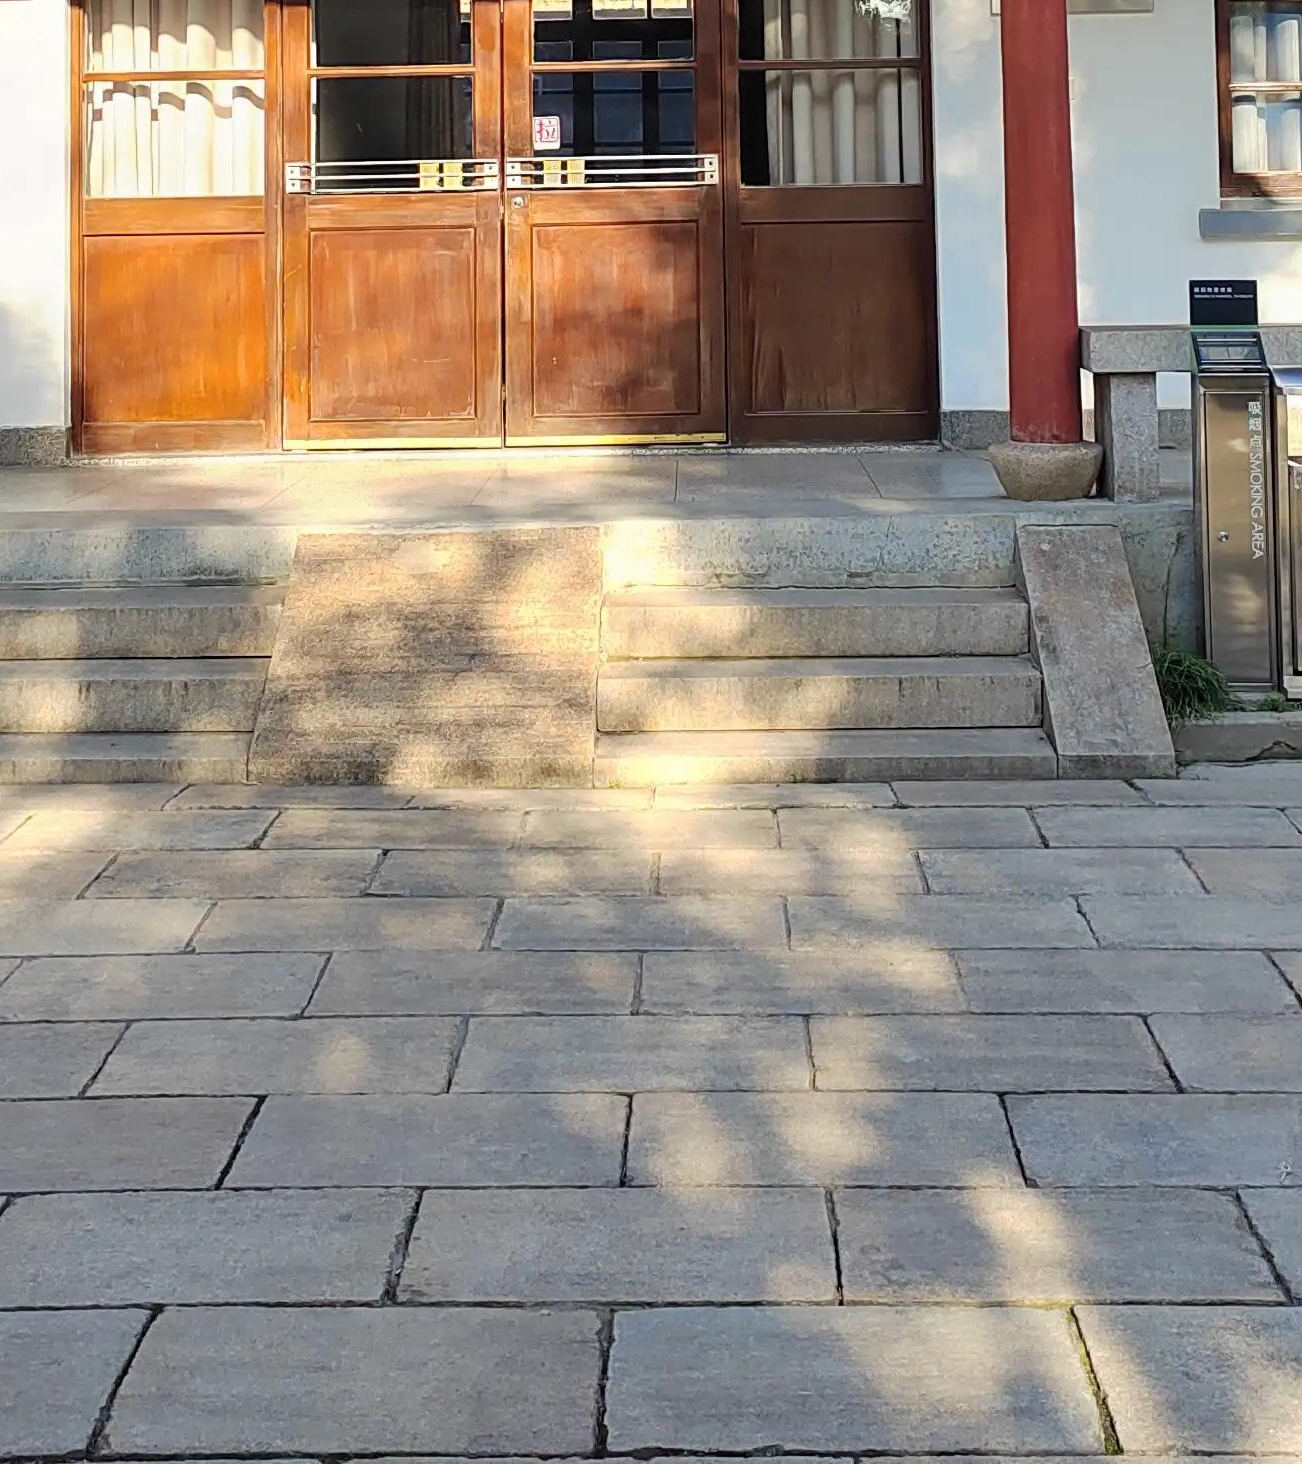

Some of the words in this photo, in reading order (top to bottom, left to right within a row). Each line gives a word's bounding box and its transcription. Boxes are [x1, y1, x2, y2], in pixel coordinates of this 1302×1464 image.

[536, 119, 556, 142] 拉
[1250, 452, 1264, 518] SMOKING
[1251, 522, 1265, 559] AREA
